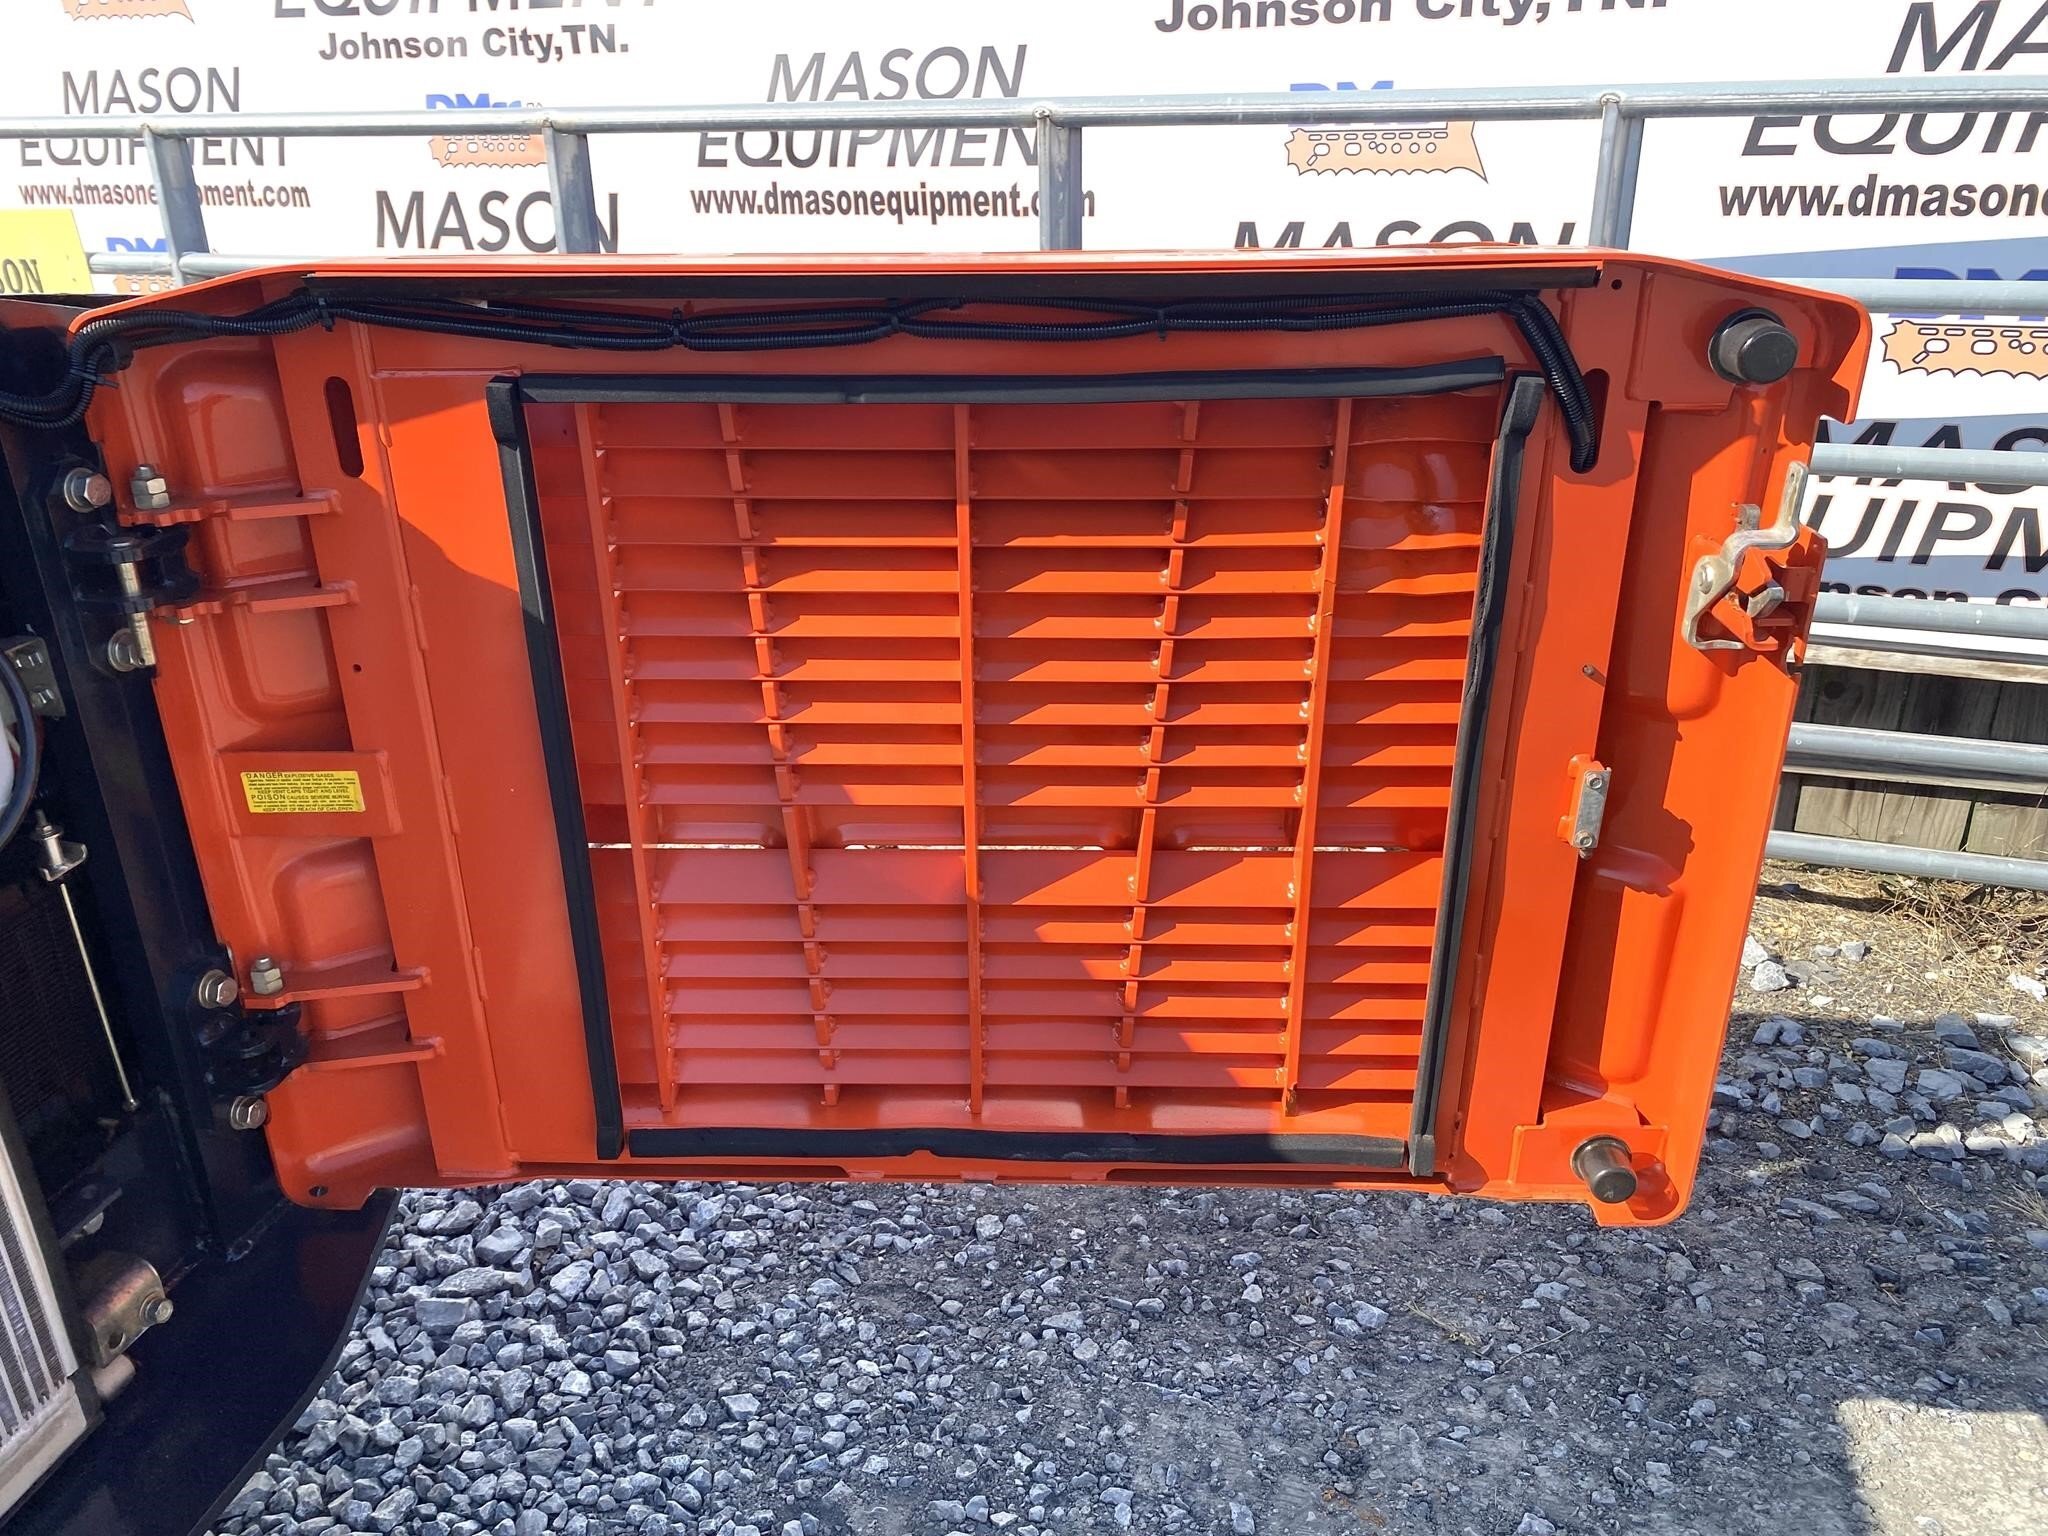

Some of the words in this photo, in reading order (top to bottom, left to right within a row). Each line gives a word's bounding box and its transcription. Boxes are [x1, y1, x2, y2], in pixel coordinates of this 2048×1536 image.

[318, 31, 468, 61] Johnson
[483, 23, 630, 63] City,TN.
[62, 66, 240, 114] MASON
[766, 44, 1027, 102] MASON
[697, 128, 1039, 168] EQUIPMEN
[690, 181, 1095, 225] www.dmasonequipment.m
[1719, 174, 2048, 216] www.dmason
